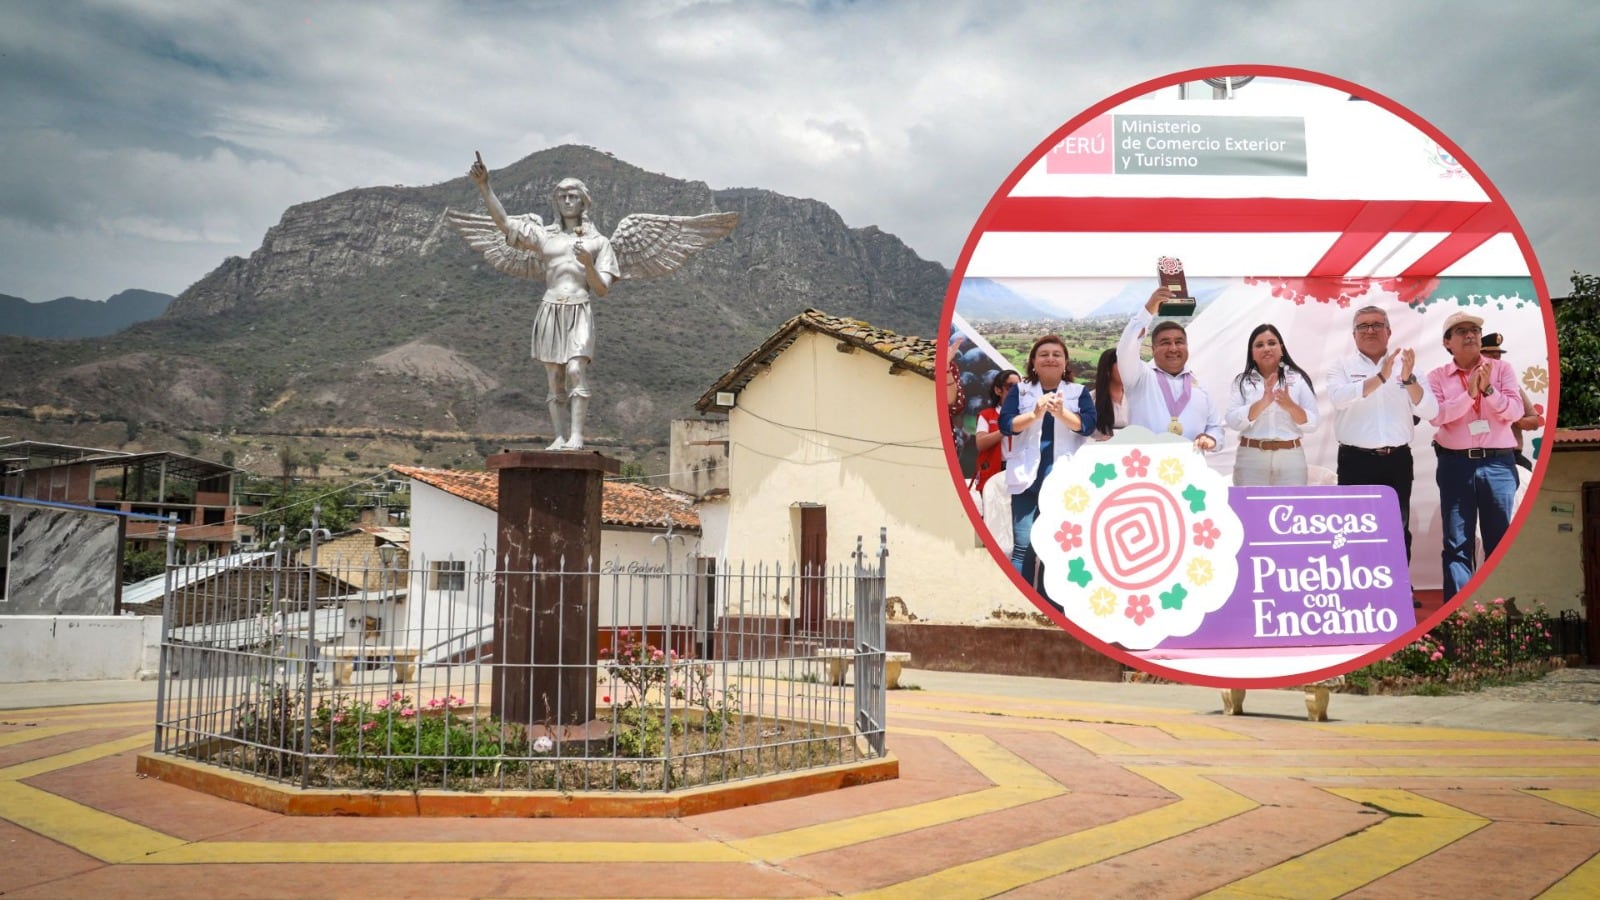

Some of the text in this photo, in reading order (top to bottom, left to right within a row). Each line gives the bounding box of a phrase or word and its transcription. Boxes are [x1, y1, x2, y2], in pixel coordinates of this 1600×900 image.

[1122, 120, 1201, 134] Ministerio
[1121, 136, 1286, 151] de Comercio Exterior
[1121, 153, 1198, 170] y Turismo
[1268, 504, 1378, 534] Cascas
[1250, 554, 1393, 593] Pueblos
[1303, 593, 1346, 611] con
[1253, 599, 1398, 638] Encanto
